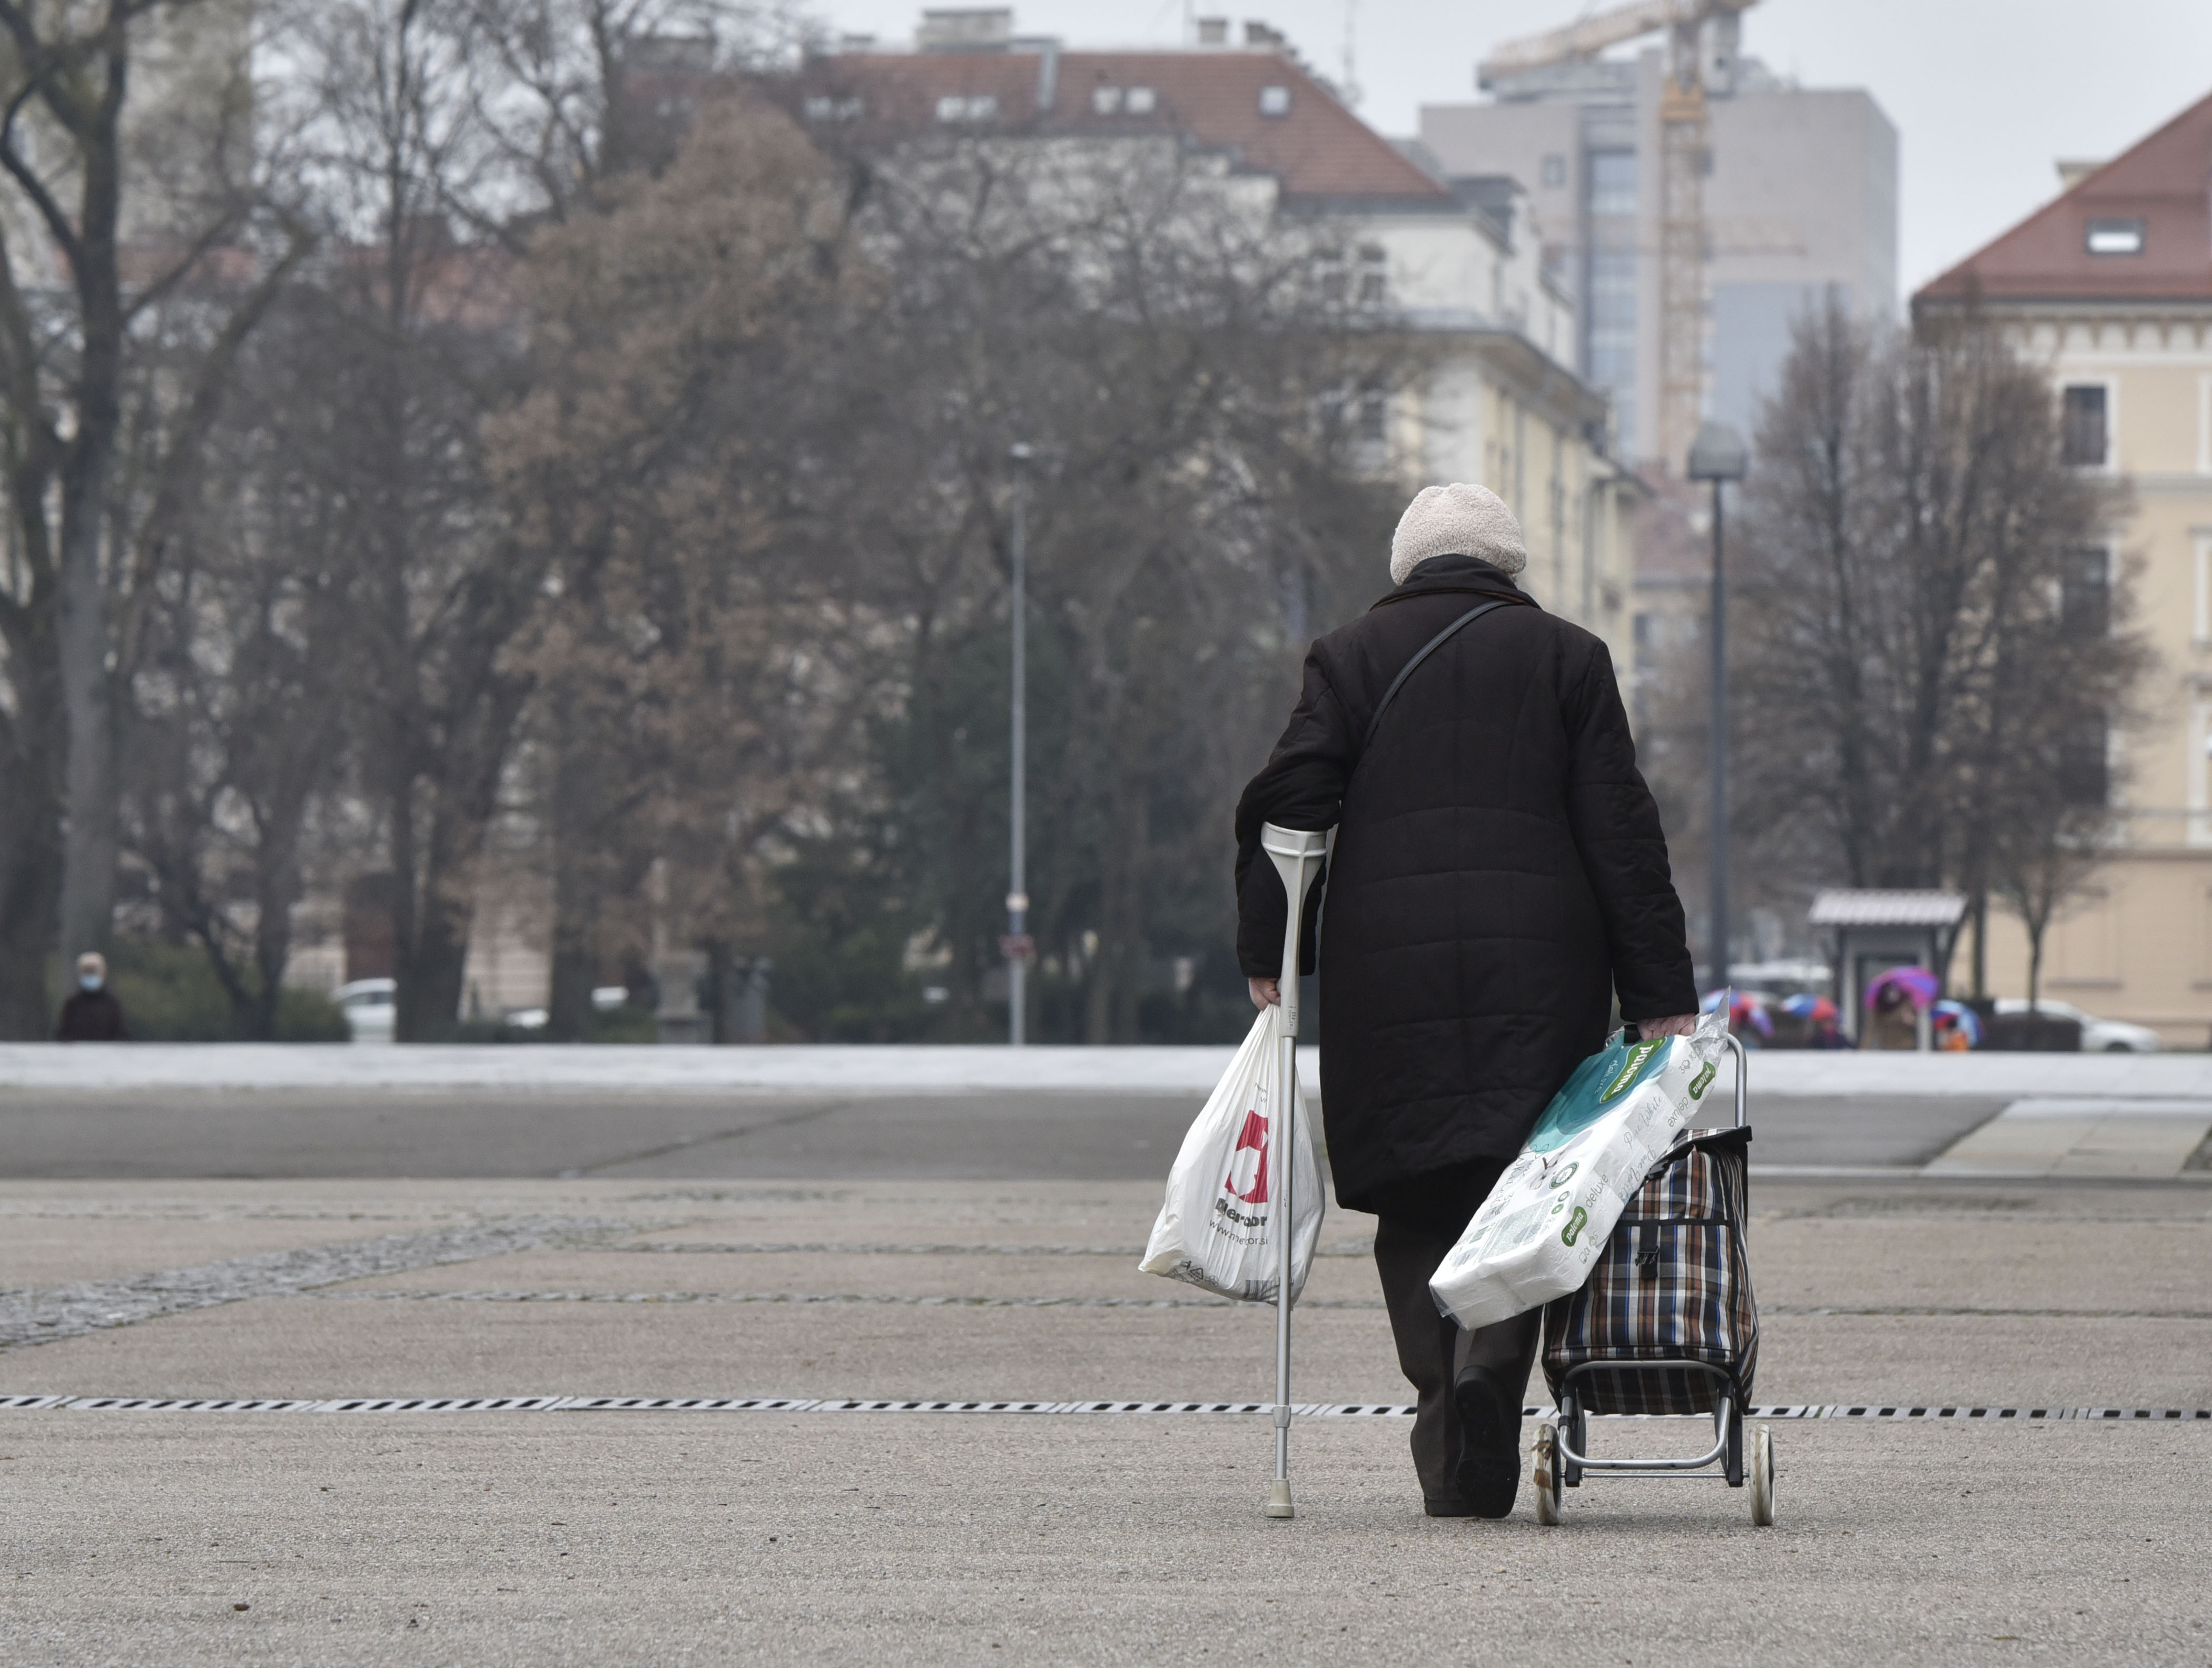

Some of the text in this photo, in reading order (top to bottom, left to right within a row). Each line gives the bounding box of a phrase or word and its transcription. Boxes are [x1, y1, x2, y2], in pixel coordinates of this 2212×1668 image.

[1611, 1045, 1653, 1094] paloma
[1667, 1097, 1689, 1127] deluxe
[1566, 1174, 1608, 1242] paloma deluxe
